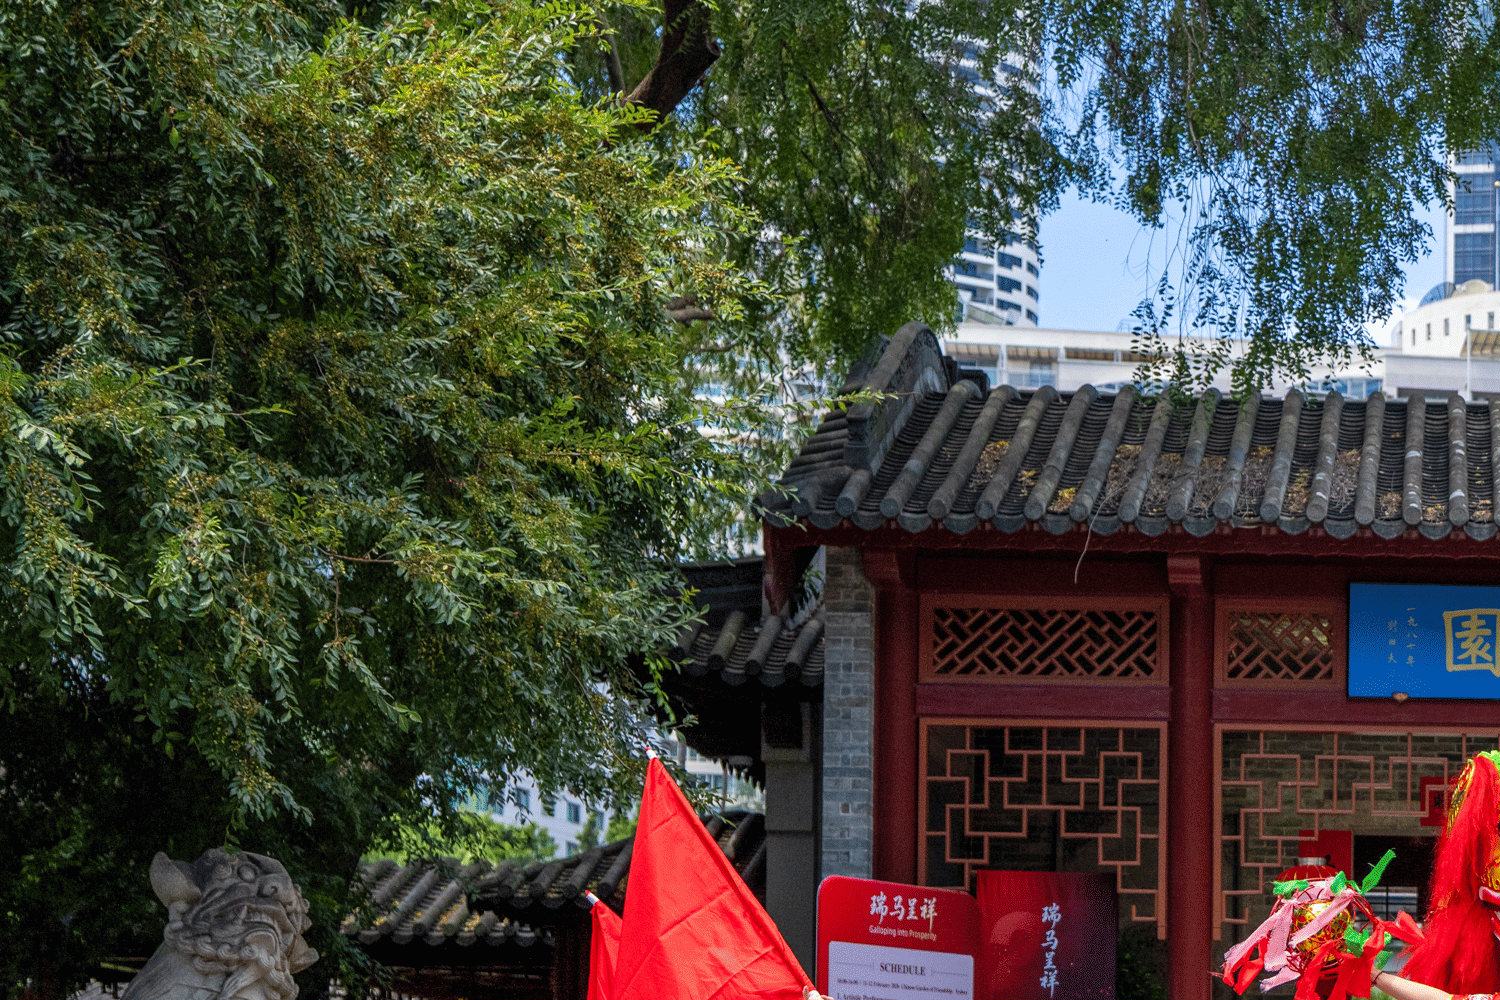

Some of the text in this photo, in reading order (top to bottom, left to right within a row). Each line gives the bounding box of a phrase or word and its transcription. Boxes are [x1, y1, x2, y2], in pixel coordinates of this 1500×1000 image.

[869, 891, 938, 933] 瑞马呈祥
[868, 925, 937, 942] Galloping into Prosperity
[1039, 902, 1062, 998] 瑞马呈祥
[880, 962, 926, 976] SCHEDULE
